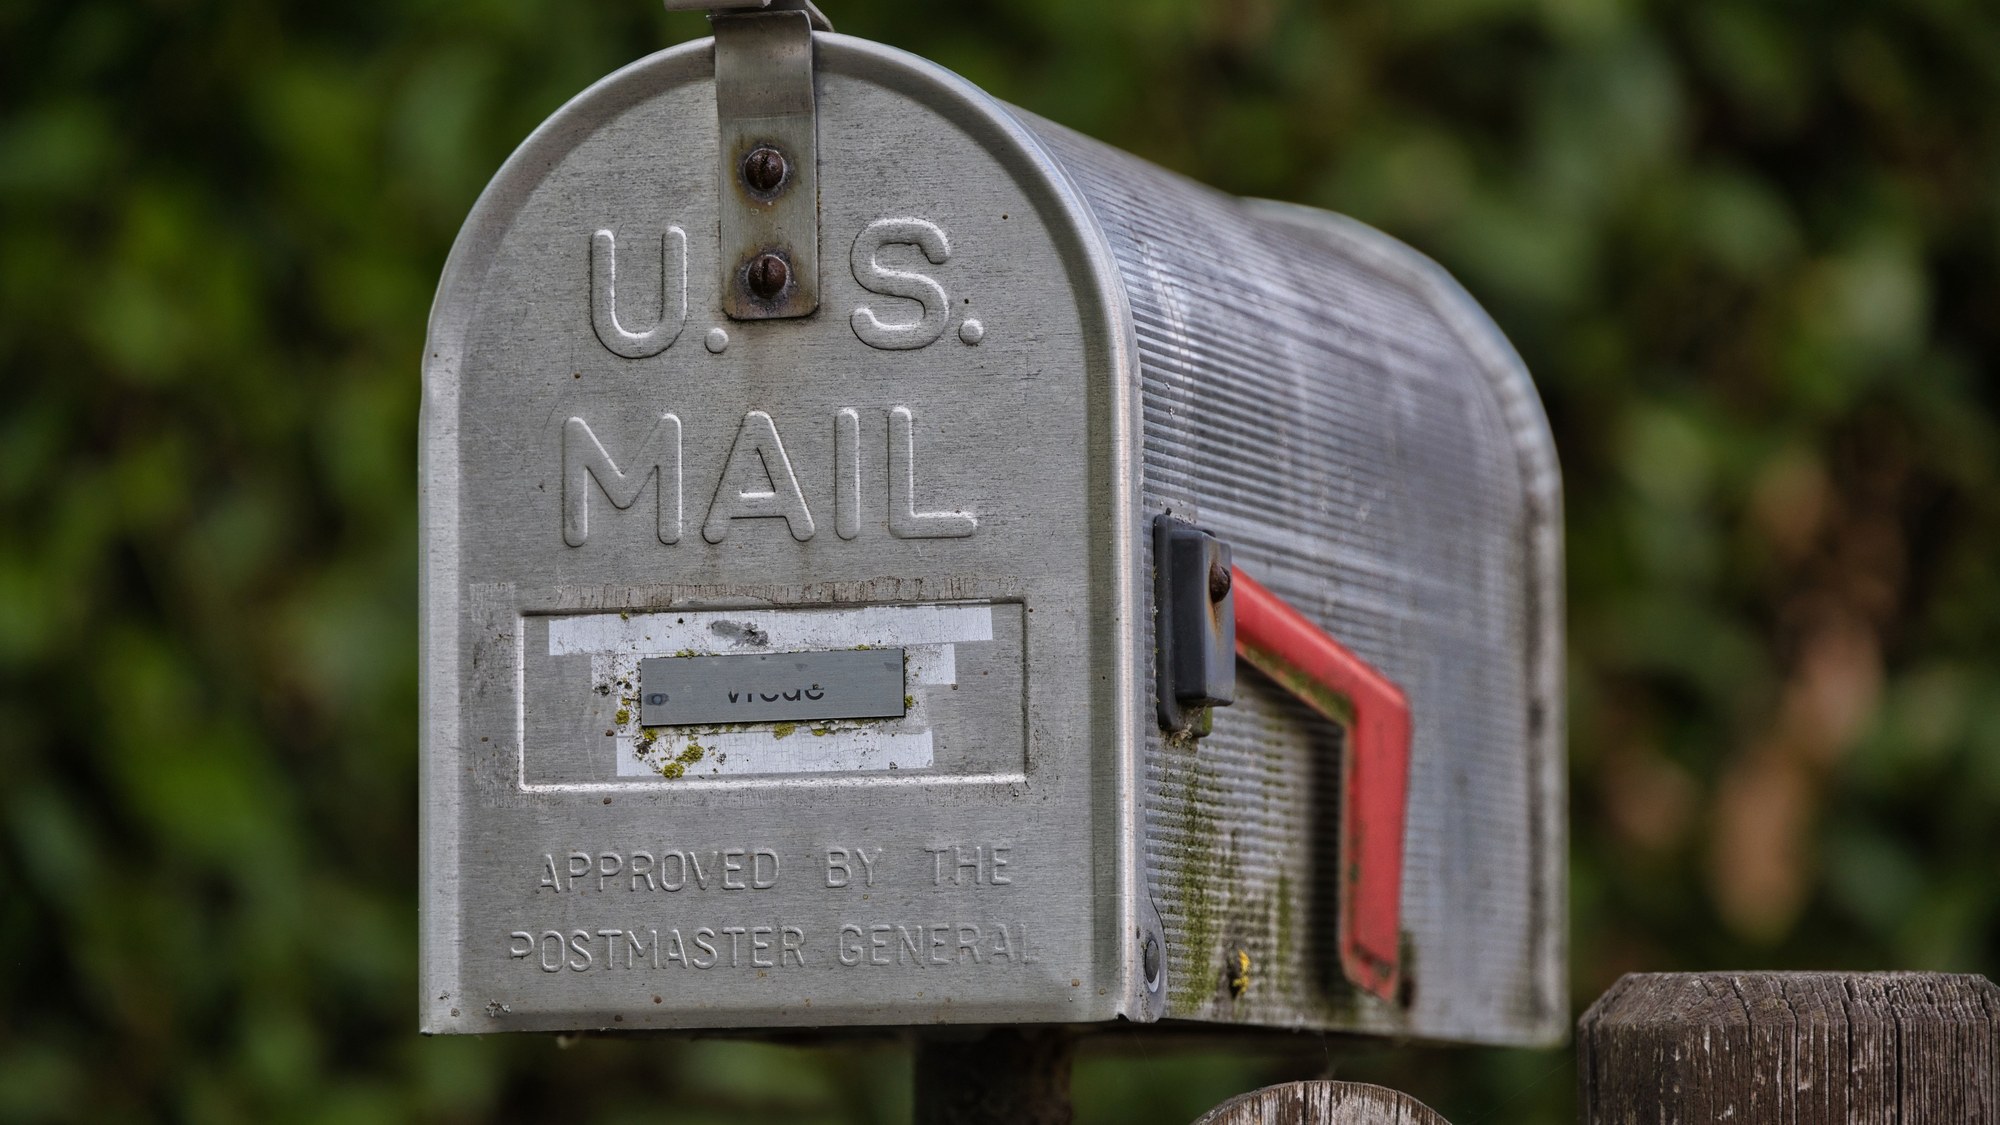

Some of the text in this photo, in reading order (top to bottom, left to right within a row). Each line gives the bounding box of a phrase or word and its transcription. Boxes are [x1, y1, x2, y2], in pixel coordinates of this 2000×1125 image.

[590, 217, 985, 359] U. S.
[562, 407, 978, 548] MAIL
[536, 845, 1012, 894] APPROVED BY THE
[509, 922, 1040, 973] POSTMASTER GENERAL
